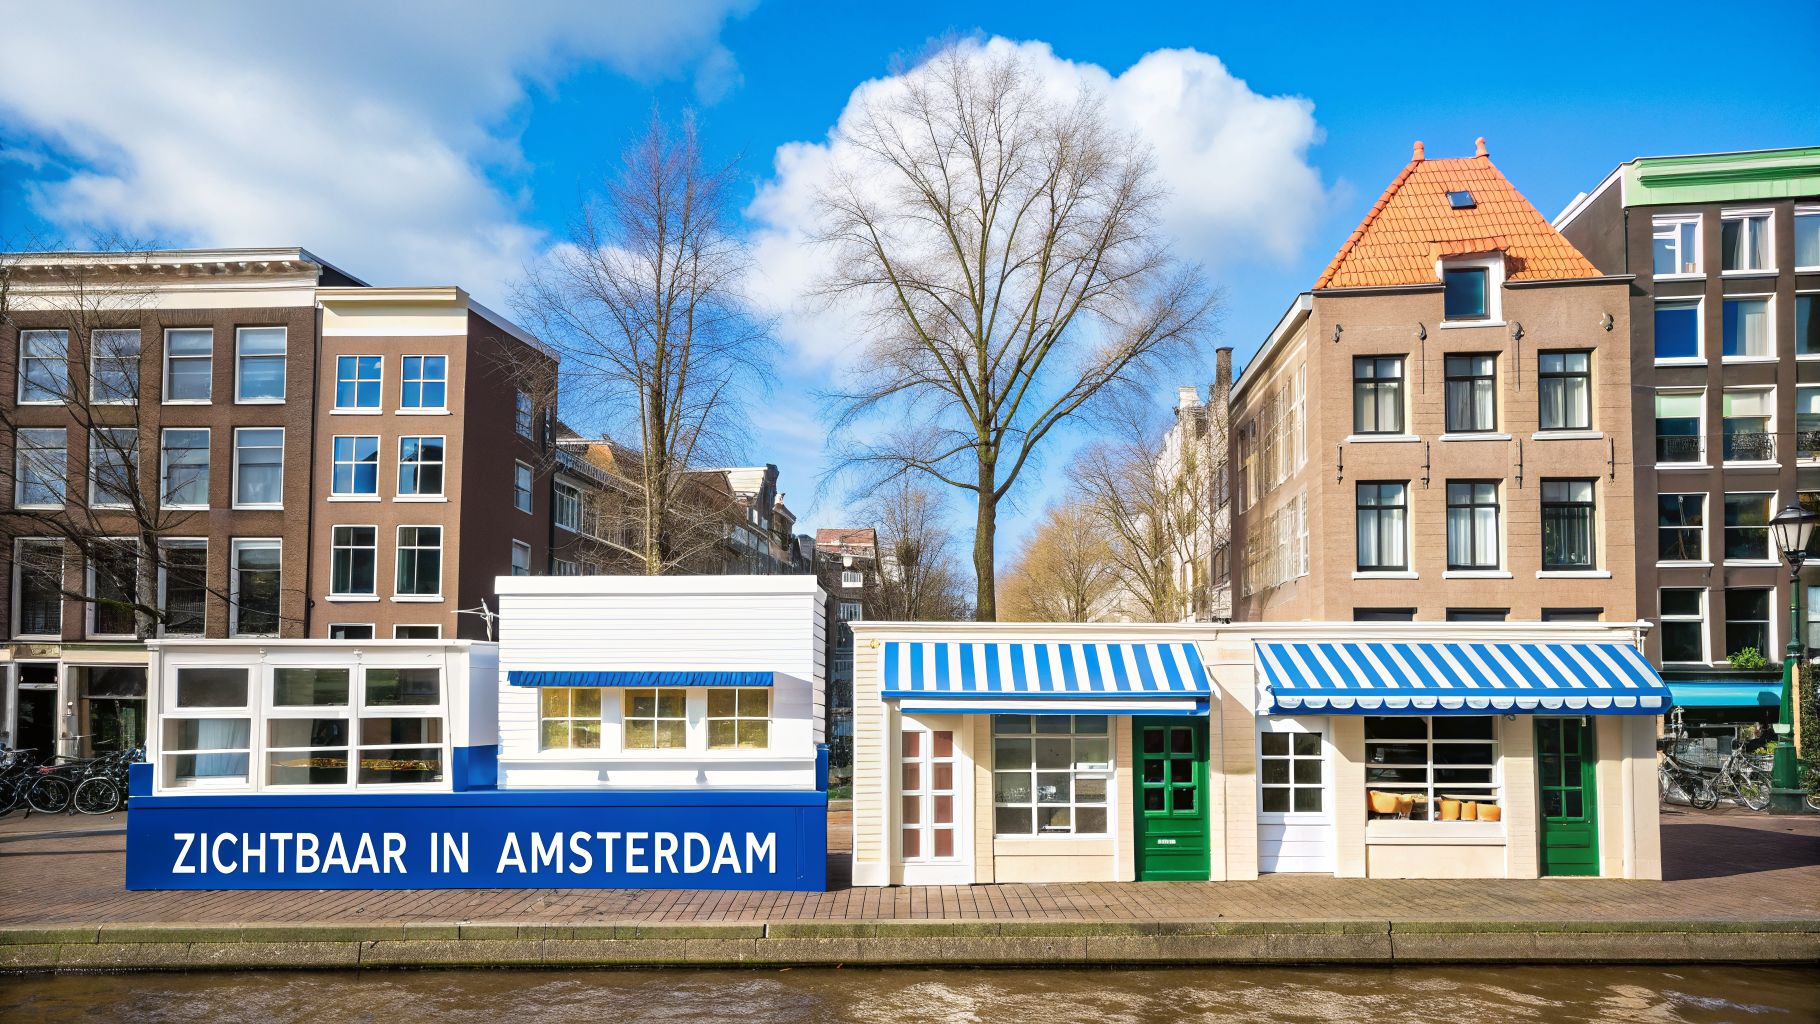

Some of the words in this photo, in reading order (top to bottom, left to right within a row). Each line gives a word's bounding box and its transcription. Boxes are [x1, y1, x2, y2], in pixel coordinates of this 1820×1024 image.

[172, 832, 407, 874] ZICHTBAAR
[430, 832, 469, 873] IN
[496, 831, 777, 874] AMSTERDAM
